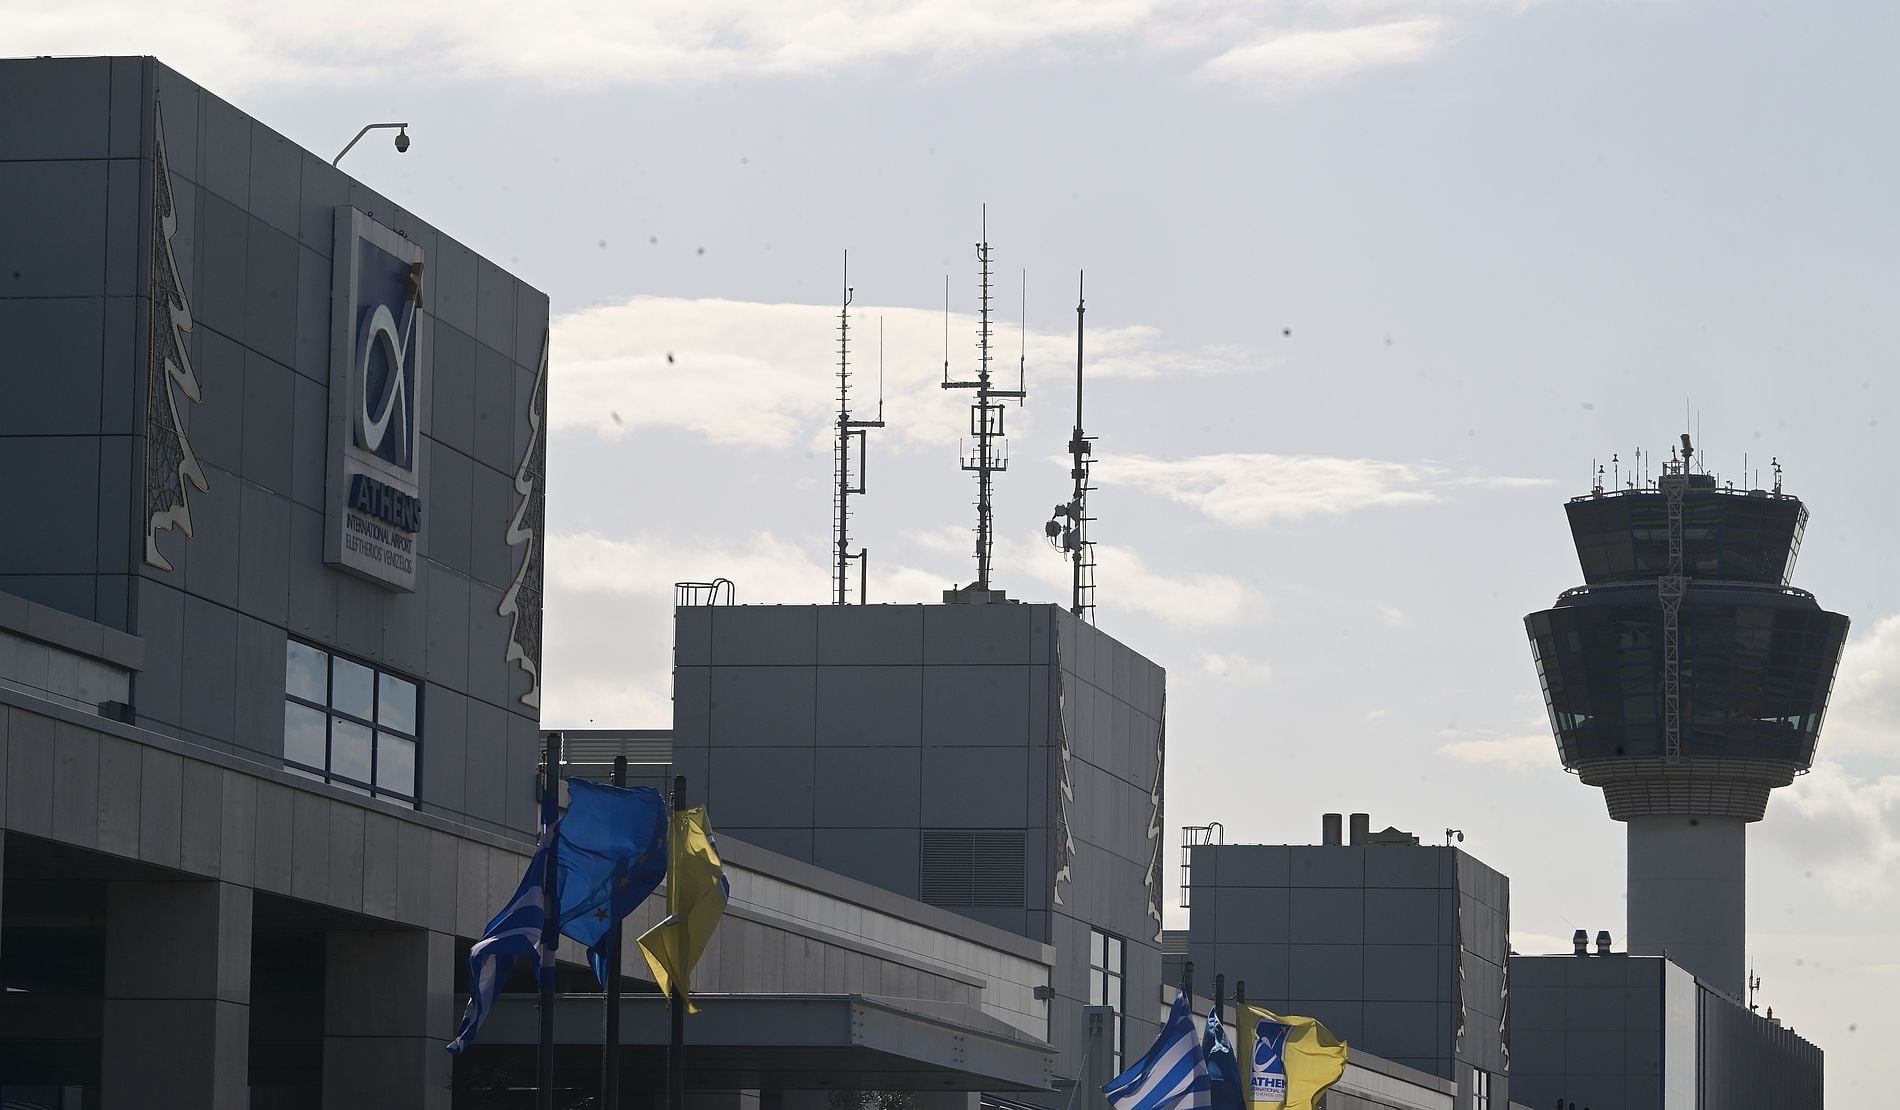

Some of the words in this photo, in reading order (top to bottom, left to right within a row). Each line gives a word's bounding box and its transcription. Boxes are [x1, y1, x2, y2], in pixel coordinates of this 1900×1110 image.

[352, 474, 421, 533] ATHENS
[346, 513, 389, 545] INTERNATIONAL
[391, 531, 412, 554] AIRPORT
[346, 533, 382, 562] ELEFTHERIOS
[383, 548, 412, 575] VENIZELOS
